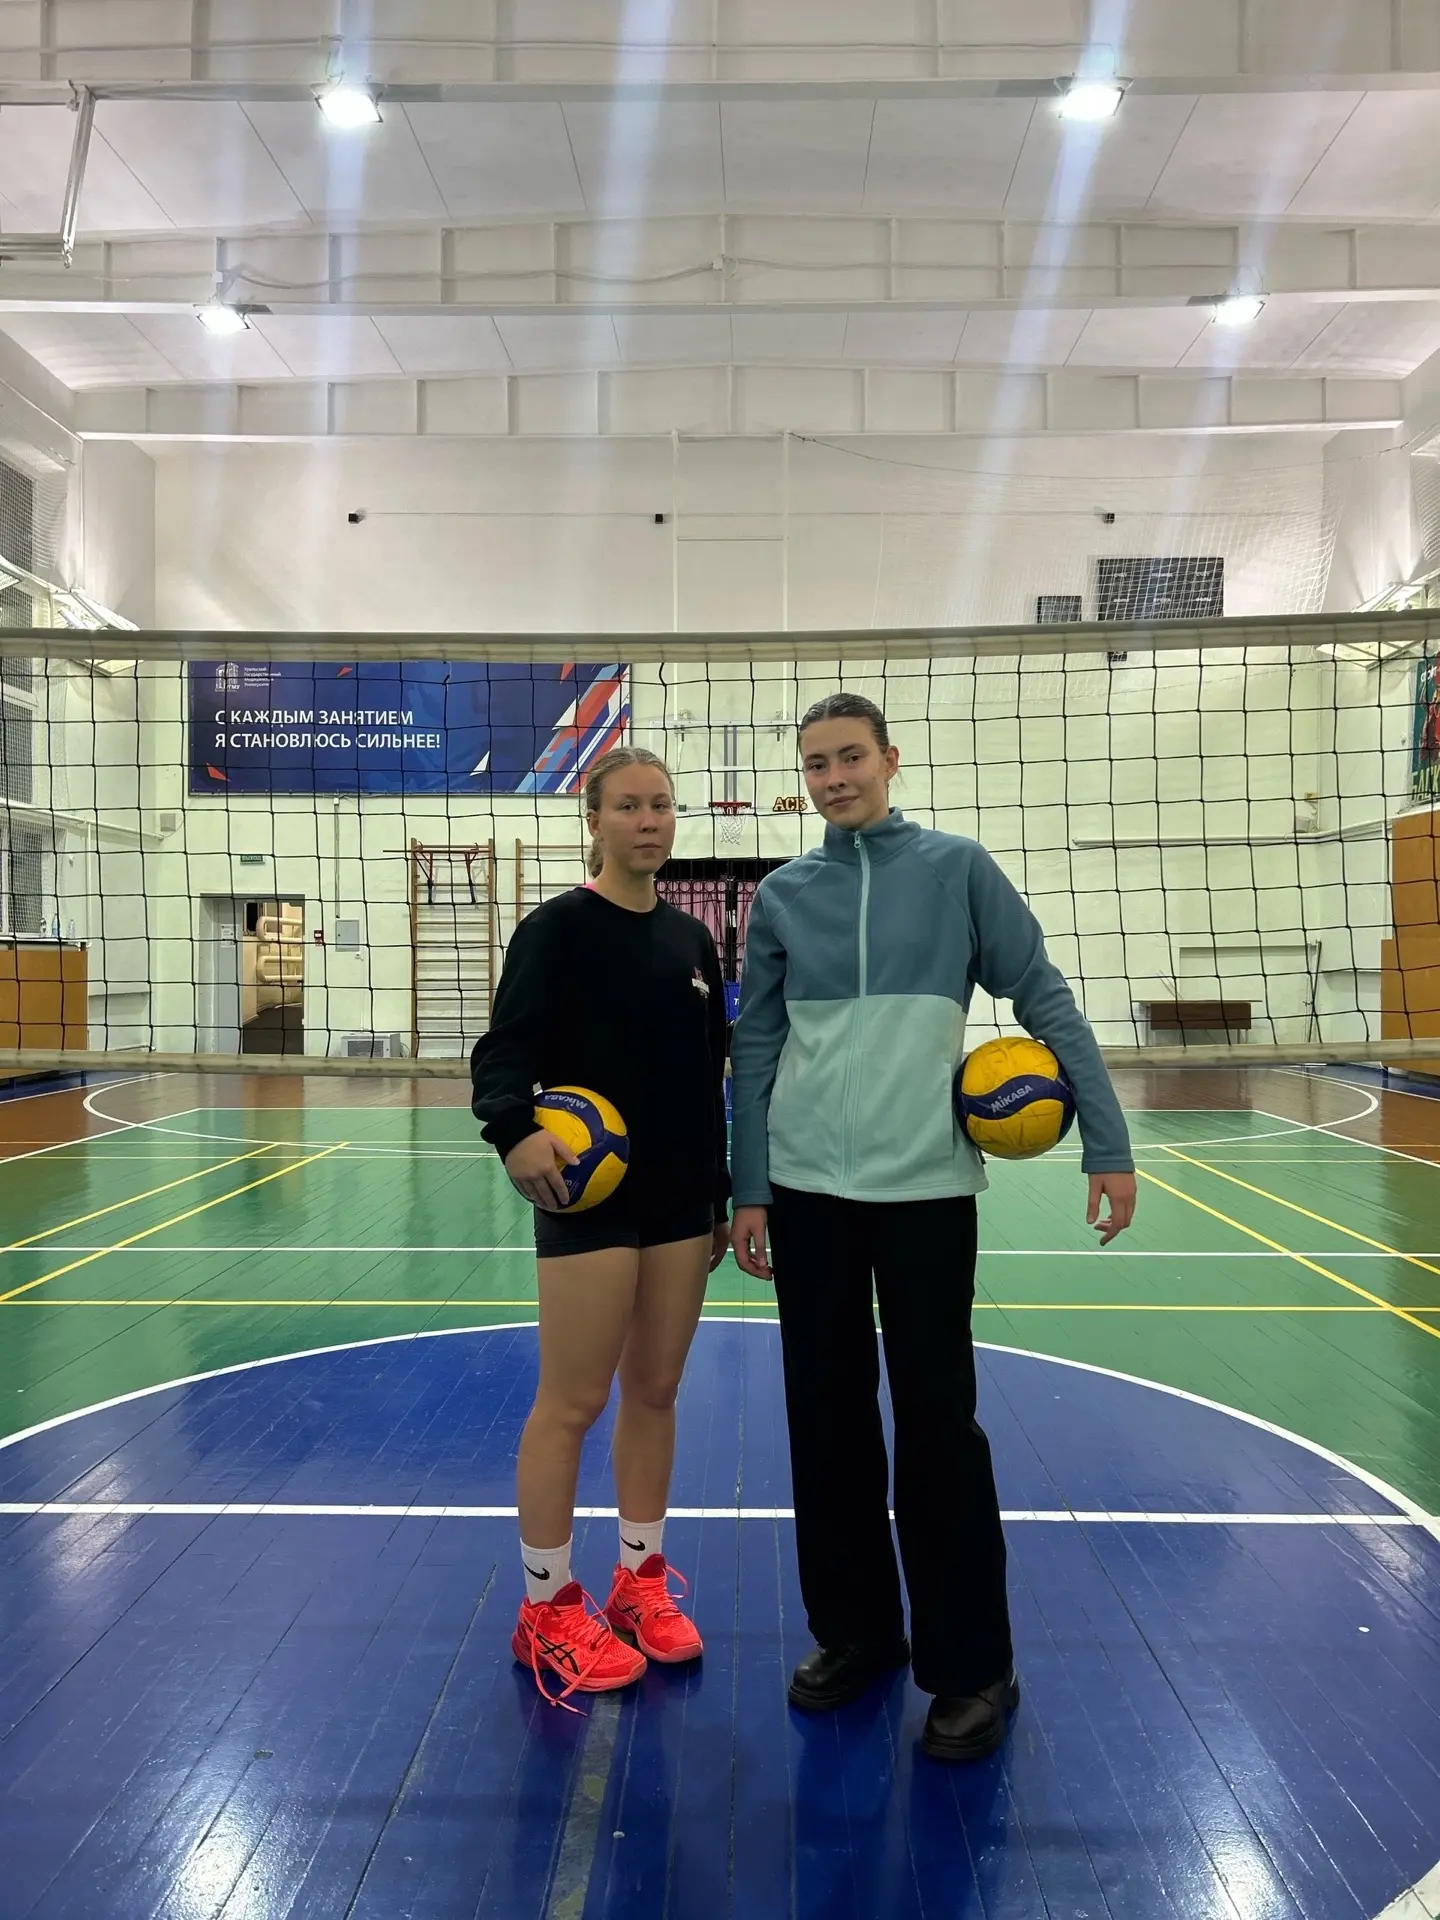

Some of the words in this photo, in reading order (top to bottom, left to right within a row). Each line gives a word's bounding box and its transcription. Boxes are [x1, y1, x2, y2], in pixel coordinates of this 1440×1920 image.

[215, 710, 225, 724] С
[231, 710, 314, 728] КАЖДЫМ
[319, 710, 414, 725] ЗАНЯТИЕМ
[215, 733, 226, 748] Я
[230, 733, 351, 748] СТАНОВЛЮСЬ
[355, 733, 440, 748] СИЛЬНЕЕ!
